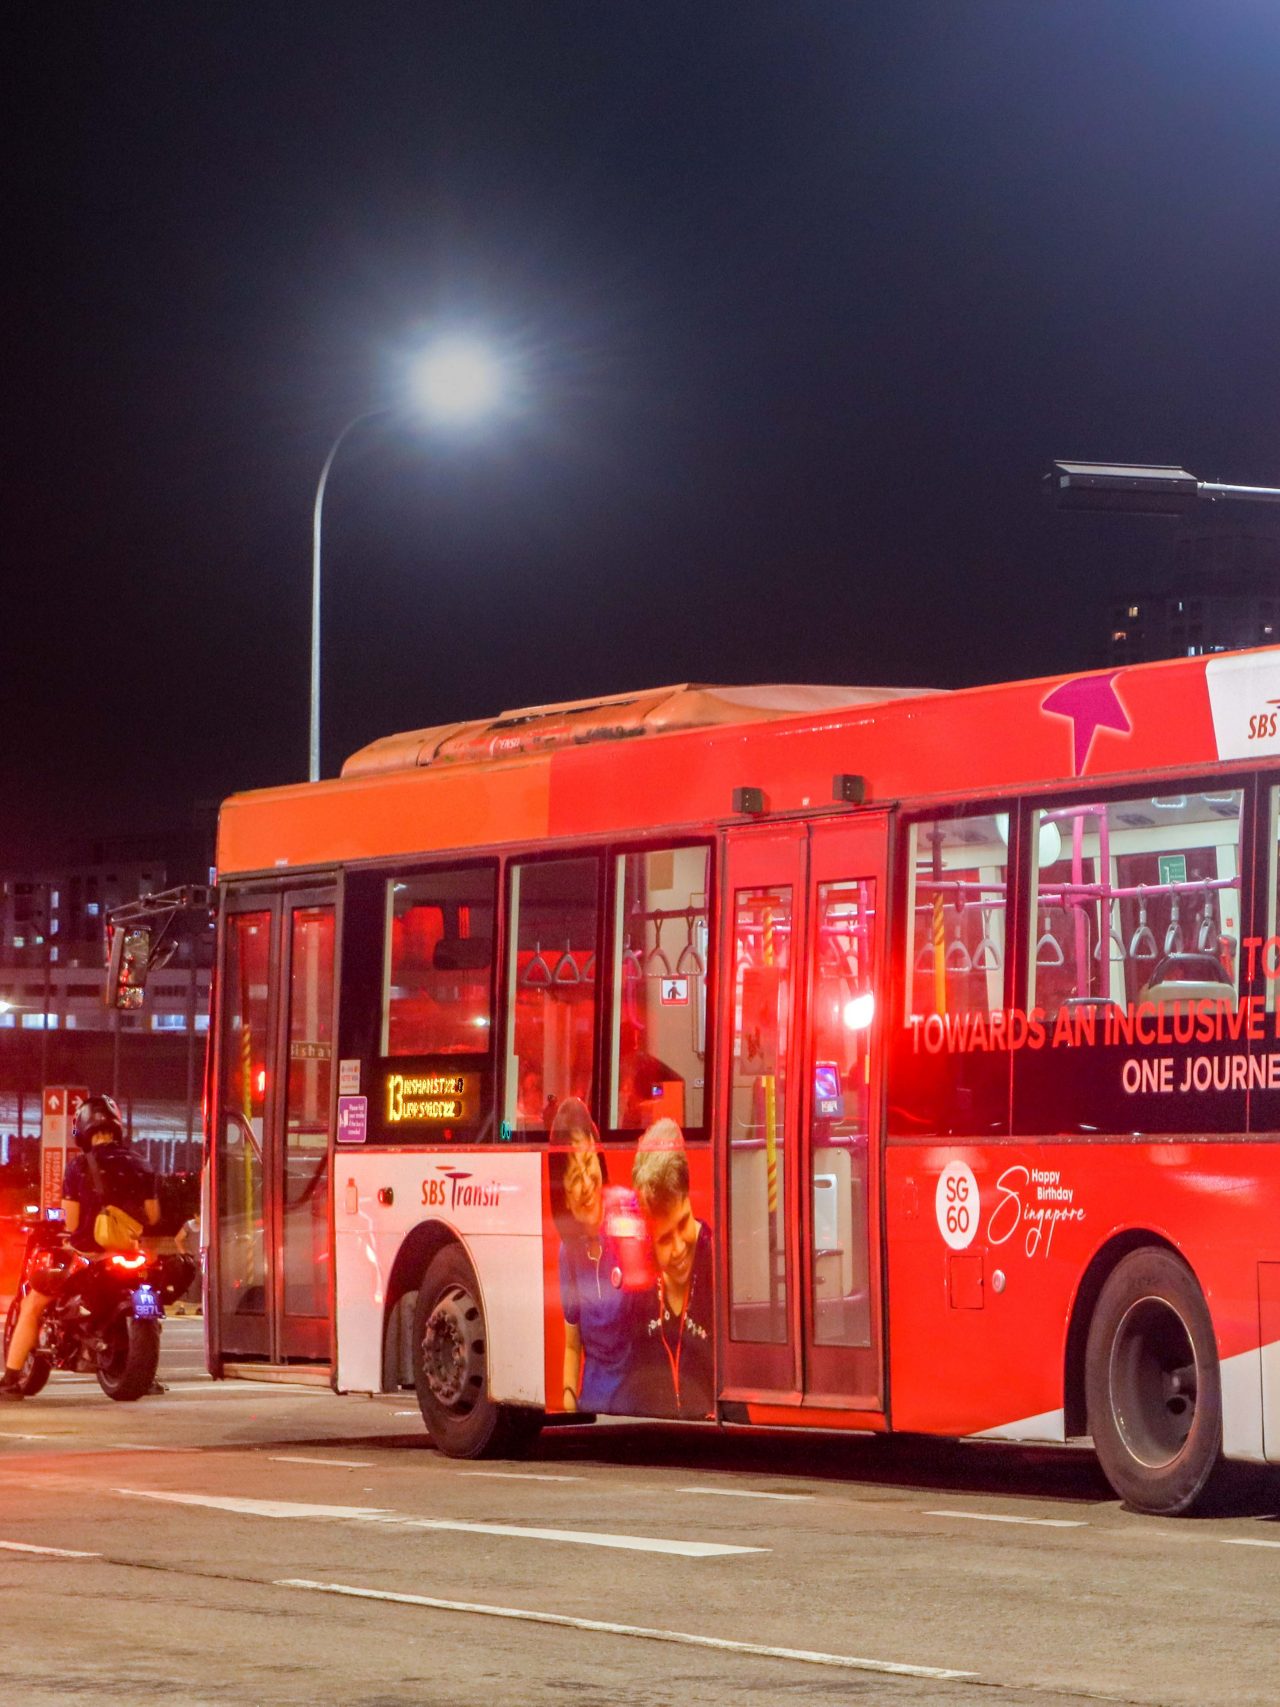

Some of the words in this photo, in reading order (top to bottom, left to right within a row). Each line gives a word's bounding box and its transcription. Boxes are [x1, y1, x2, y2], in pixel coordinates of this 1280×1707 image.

[1248, 712, 1277, 739] SBS
[910, 1007, 1045, 1053] TOWARDS
[1052, 1005, 1096, 1047] AN
[1105, 996, 1265, 1046] INCLUSIVE
[1122, 1057, 1173, 1093] ONE
[946, 1176, 969, 1202] SG
[1031, 1169, 1060, 1184] Happy
[421, 1180, 446, 1205] SBS
[1037, 1187, 1073, 1202] Birthday
[946, 1205, 969, 1233] 60
[987, 1165, 1086, 1259] Singapore
